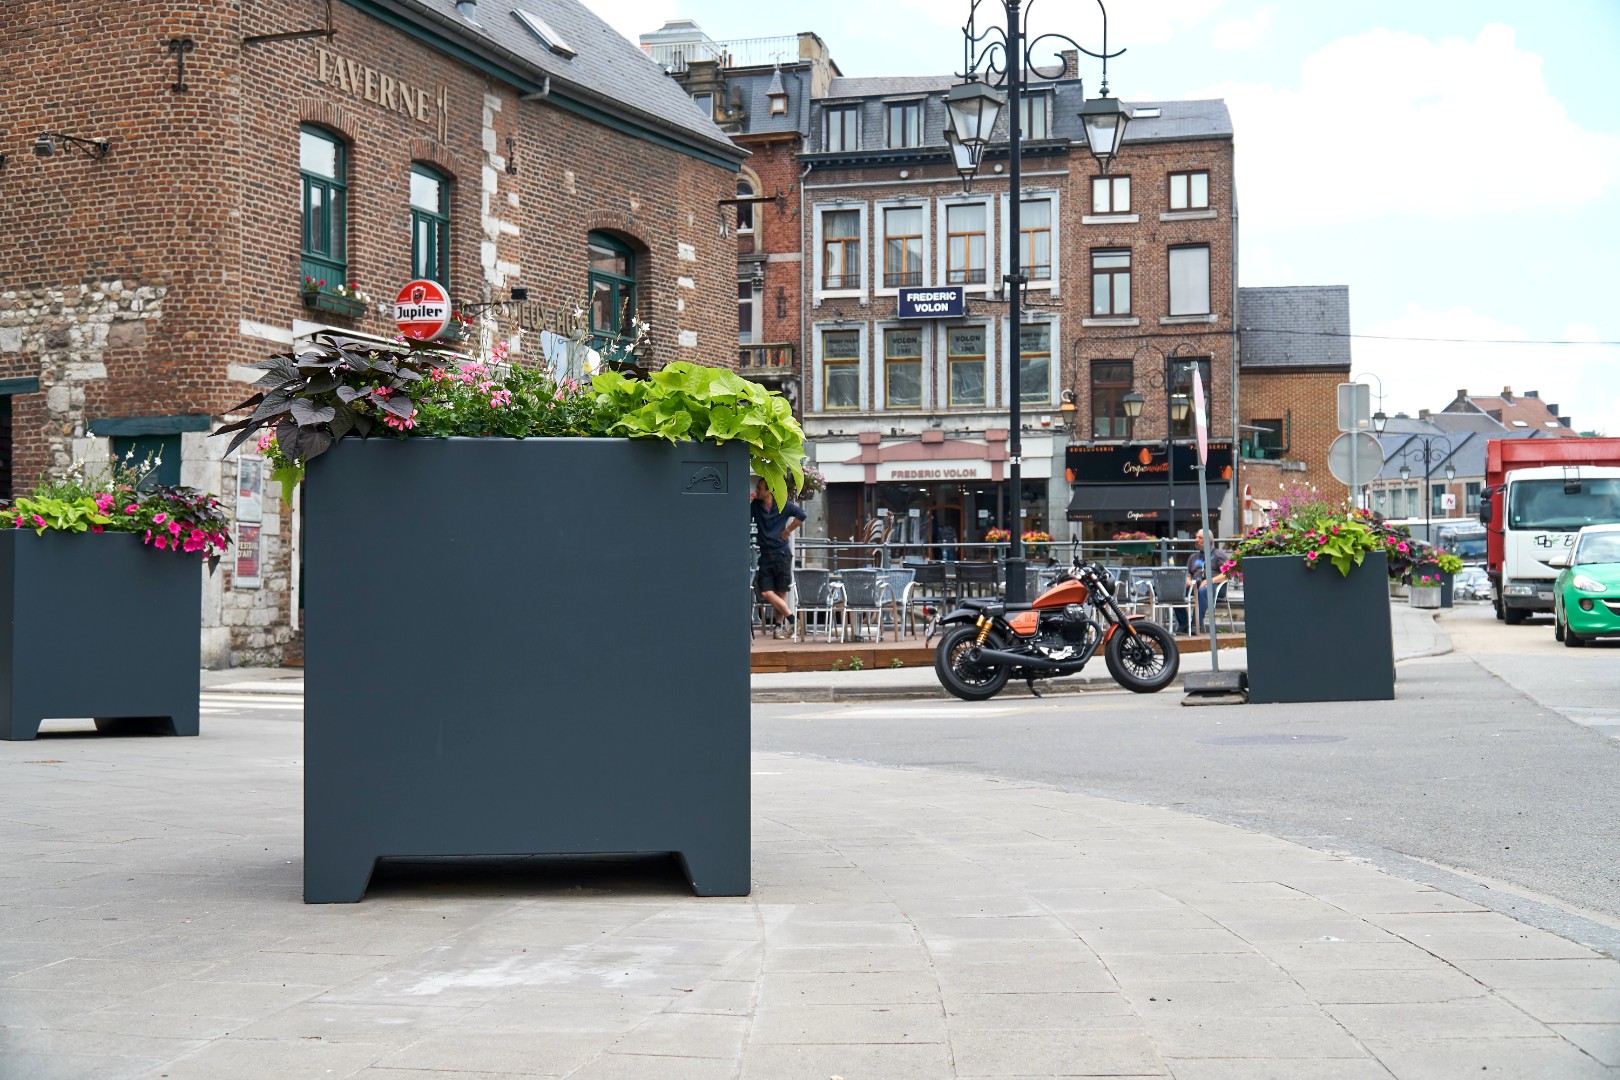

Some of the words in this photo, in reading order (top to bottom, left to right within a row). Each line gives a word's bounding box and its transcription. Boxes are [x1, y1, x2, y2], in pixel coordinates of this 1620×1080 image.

[314, 46, 430, 124] TAVERNE
[906, 291, 957, 302] FREDERIC
[397, 305, 443, 320] Jupiler
[914, 303, 949, 313] VOLON
[891, 469, 941, 479] FREDERIC
[943, 468, 977, 478] VOLON
